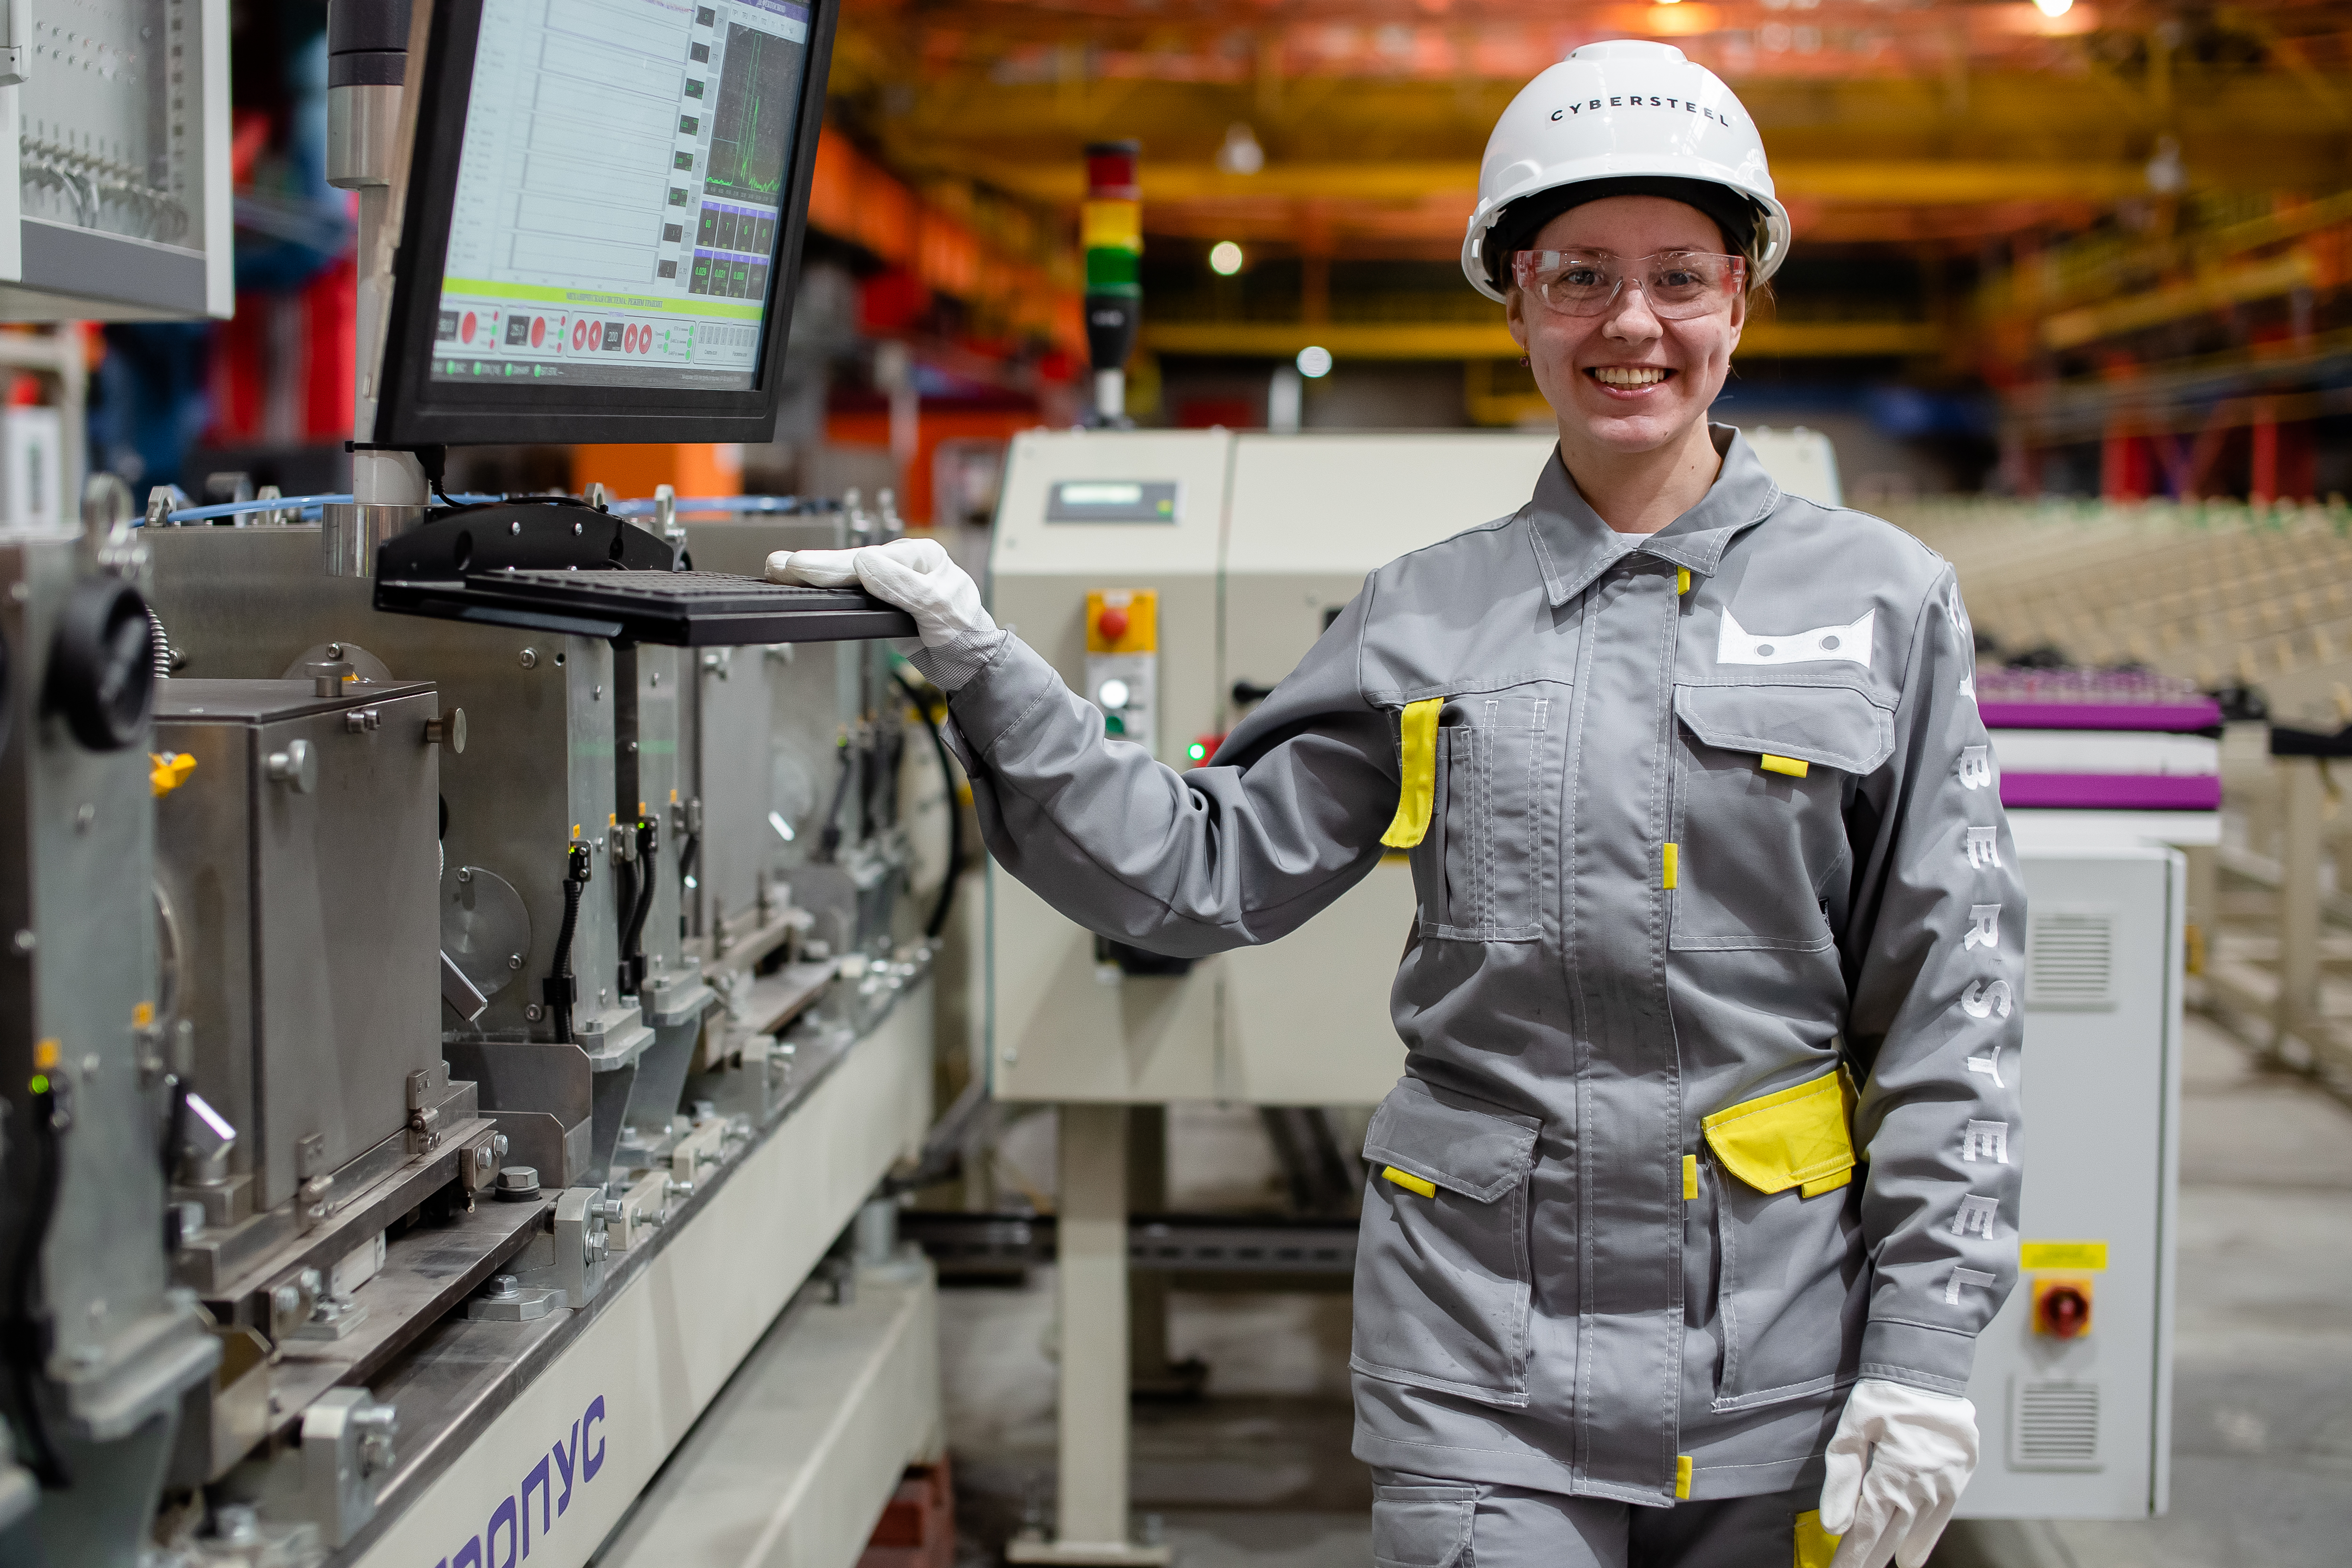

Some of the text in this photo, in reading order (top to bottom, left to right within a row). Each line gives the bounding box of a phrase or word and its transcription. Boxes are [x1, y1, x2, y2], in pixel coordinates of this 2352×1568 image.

[1551, 96, 1729, 128] CYBERSTEEL
[726, 222, 729, 231] 7
[744, 225, 748, 235] 0
[695, 267, 707, 276] 0.029
[714, 269, 726, 279] 0.021
[434, 1395, 606, 1568] ОПУС
